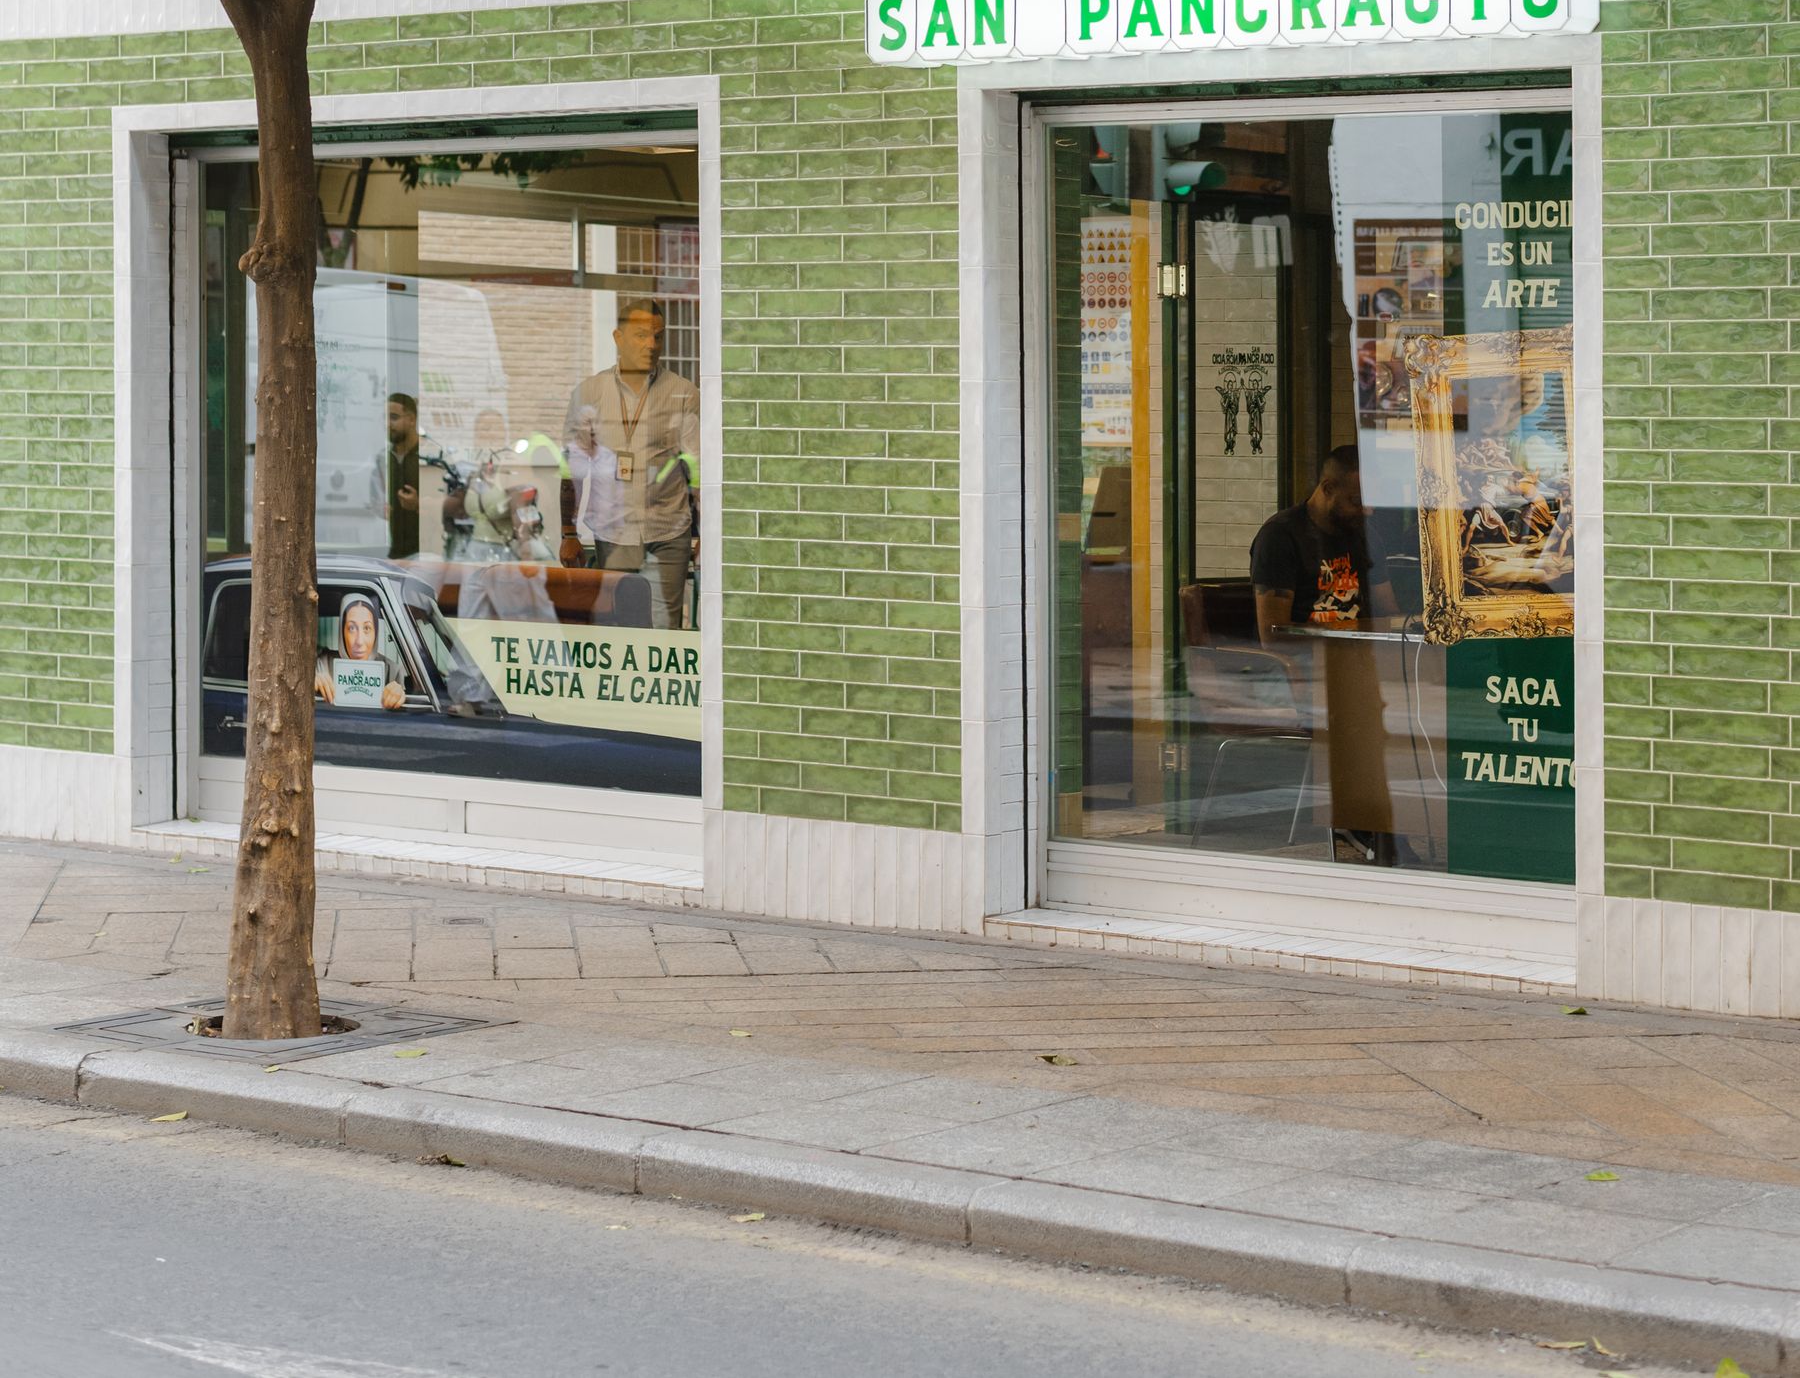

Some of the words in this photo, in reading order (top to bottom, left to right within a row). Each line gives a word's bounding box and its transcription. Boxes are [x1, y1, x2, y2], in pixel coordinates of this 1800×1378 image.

[1454, 200, 1573, 230] CONDUCI
[1486, 241, 1515, 267] ES
[1519, 240, 1553, 266] UN
[1481, 277, 1561, 309] ARTE
[491, 636, 520, 664] TE
[527, 638, 612, 670] VAMOS
[621, 644, 640, 672] A
[648, 646, 699, 675] DAR
[337, 675, 381, 688] PANCRACIO
[506, 668, 585, 699] HASTA
[597, 673, 625, 702] EL
[630, 676, 702, 708] CARN
[1485, 675, 1562, 707] SACA
[1507, 717, 1539, 742] TU
